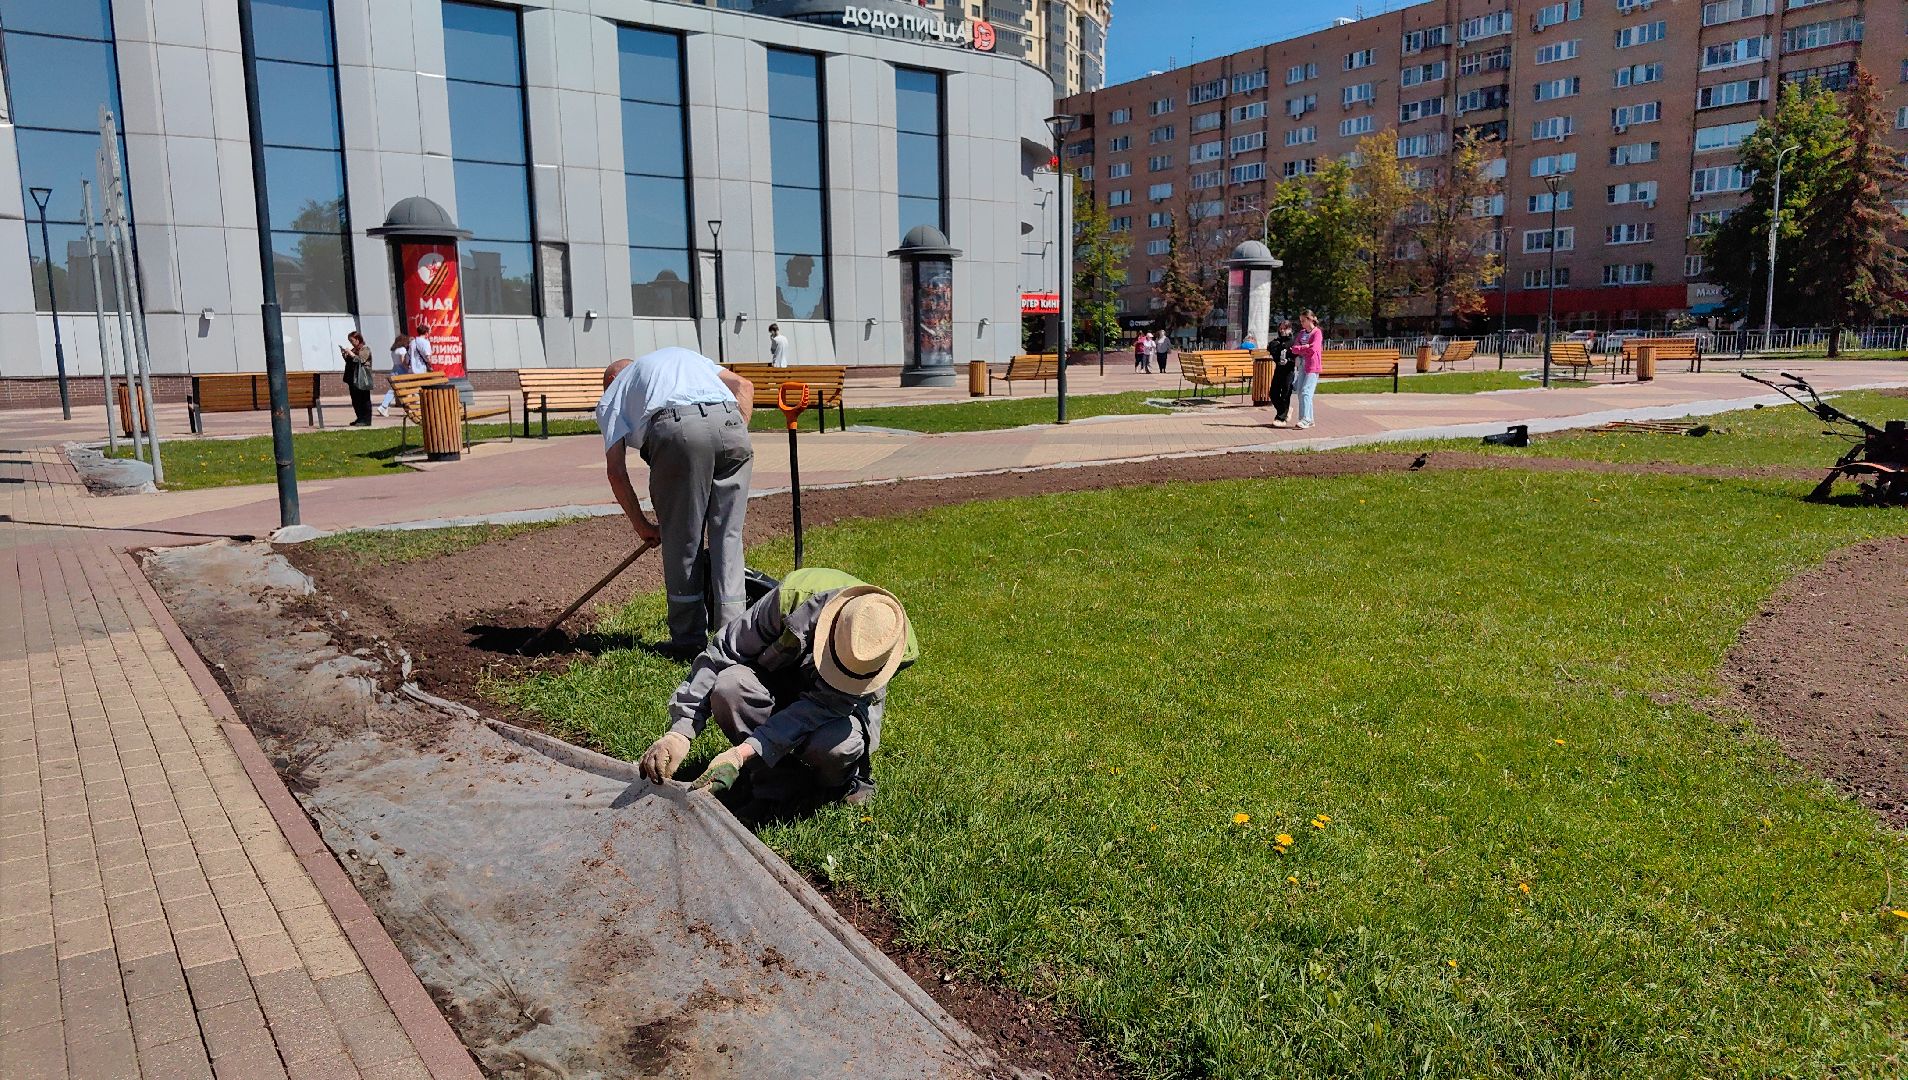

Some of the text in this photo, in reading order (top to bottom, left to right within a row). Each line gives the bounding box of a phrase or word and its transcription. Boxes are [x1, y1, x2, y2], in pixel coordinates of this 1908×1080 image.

[843, 6, 966, 42] ДОДО ПИЦЦА
[419, 298, 453, 310] МАЯ
[431, 342, 462, 355] ЛИКОЙ
[429, 354, 462, 366] БЕДЫ!
